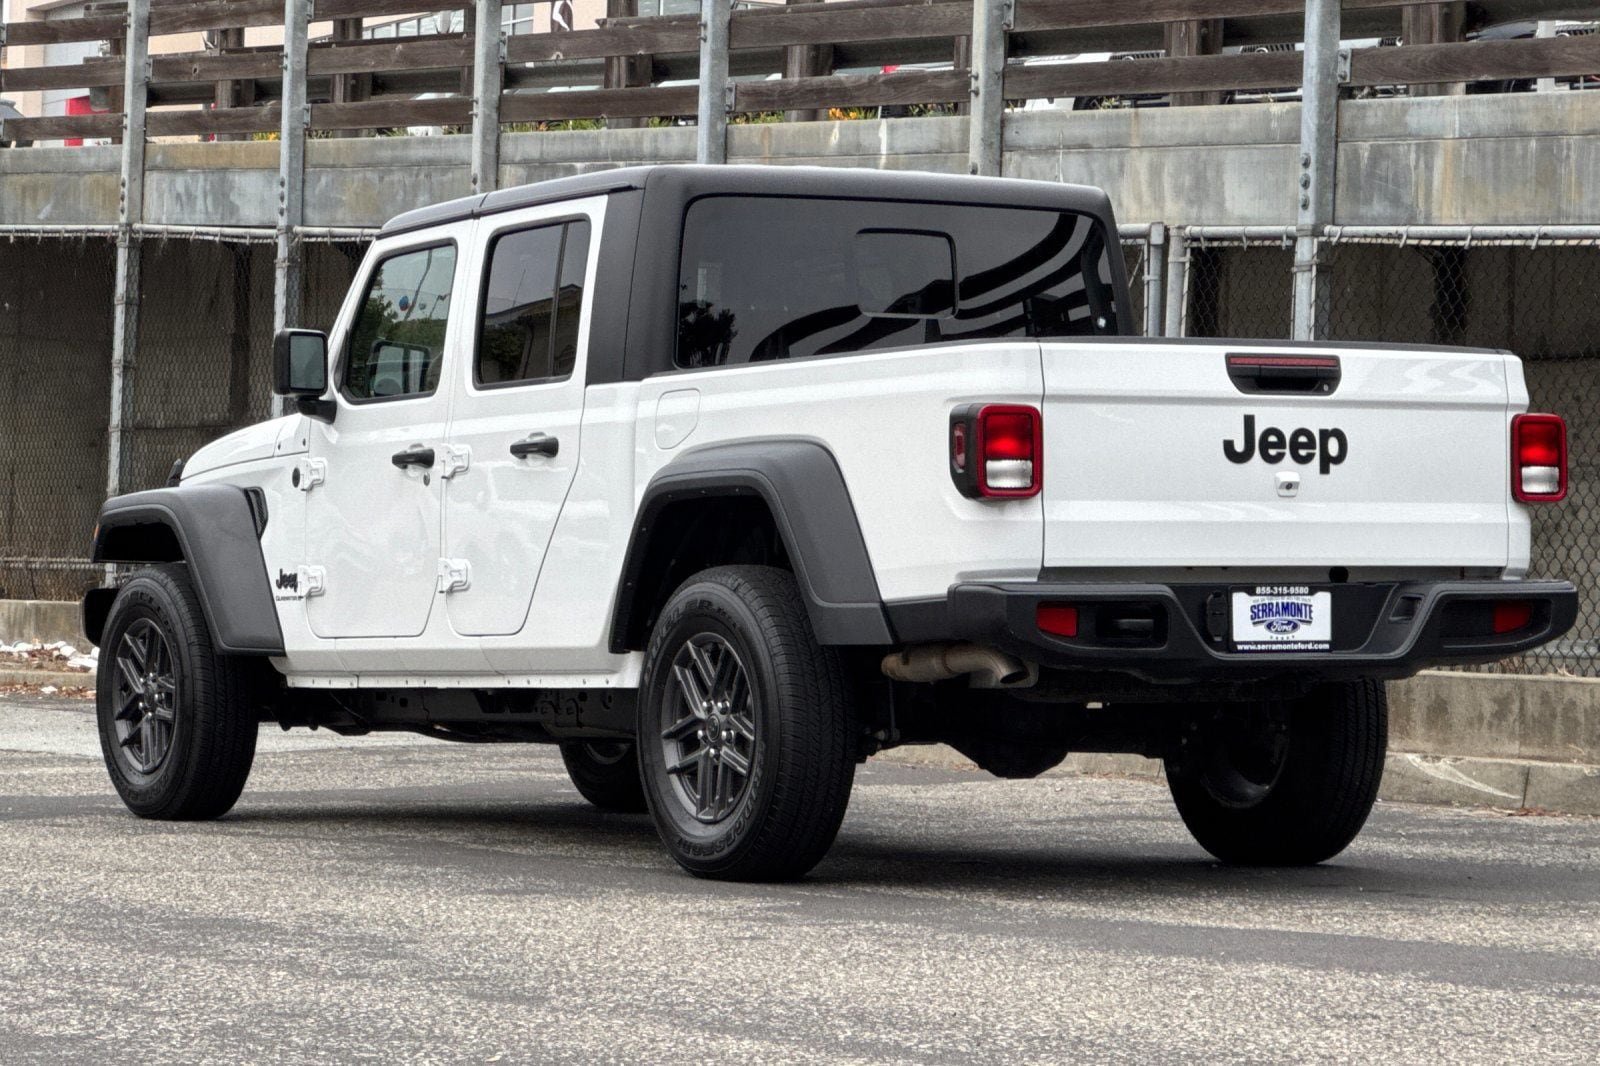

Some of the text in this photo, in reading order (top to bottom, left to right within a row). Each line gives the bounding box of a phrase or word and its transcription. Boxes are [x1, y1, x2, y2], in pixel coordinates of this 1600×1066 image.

[1223, 414, 1348, 475] Jeep
[276, 568, 298, 593] Jeep
[1250, 601, 1313, 621] SERRAMONTE
[1270, 620, 1294, 632] Ford
